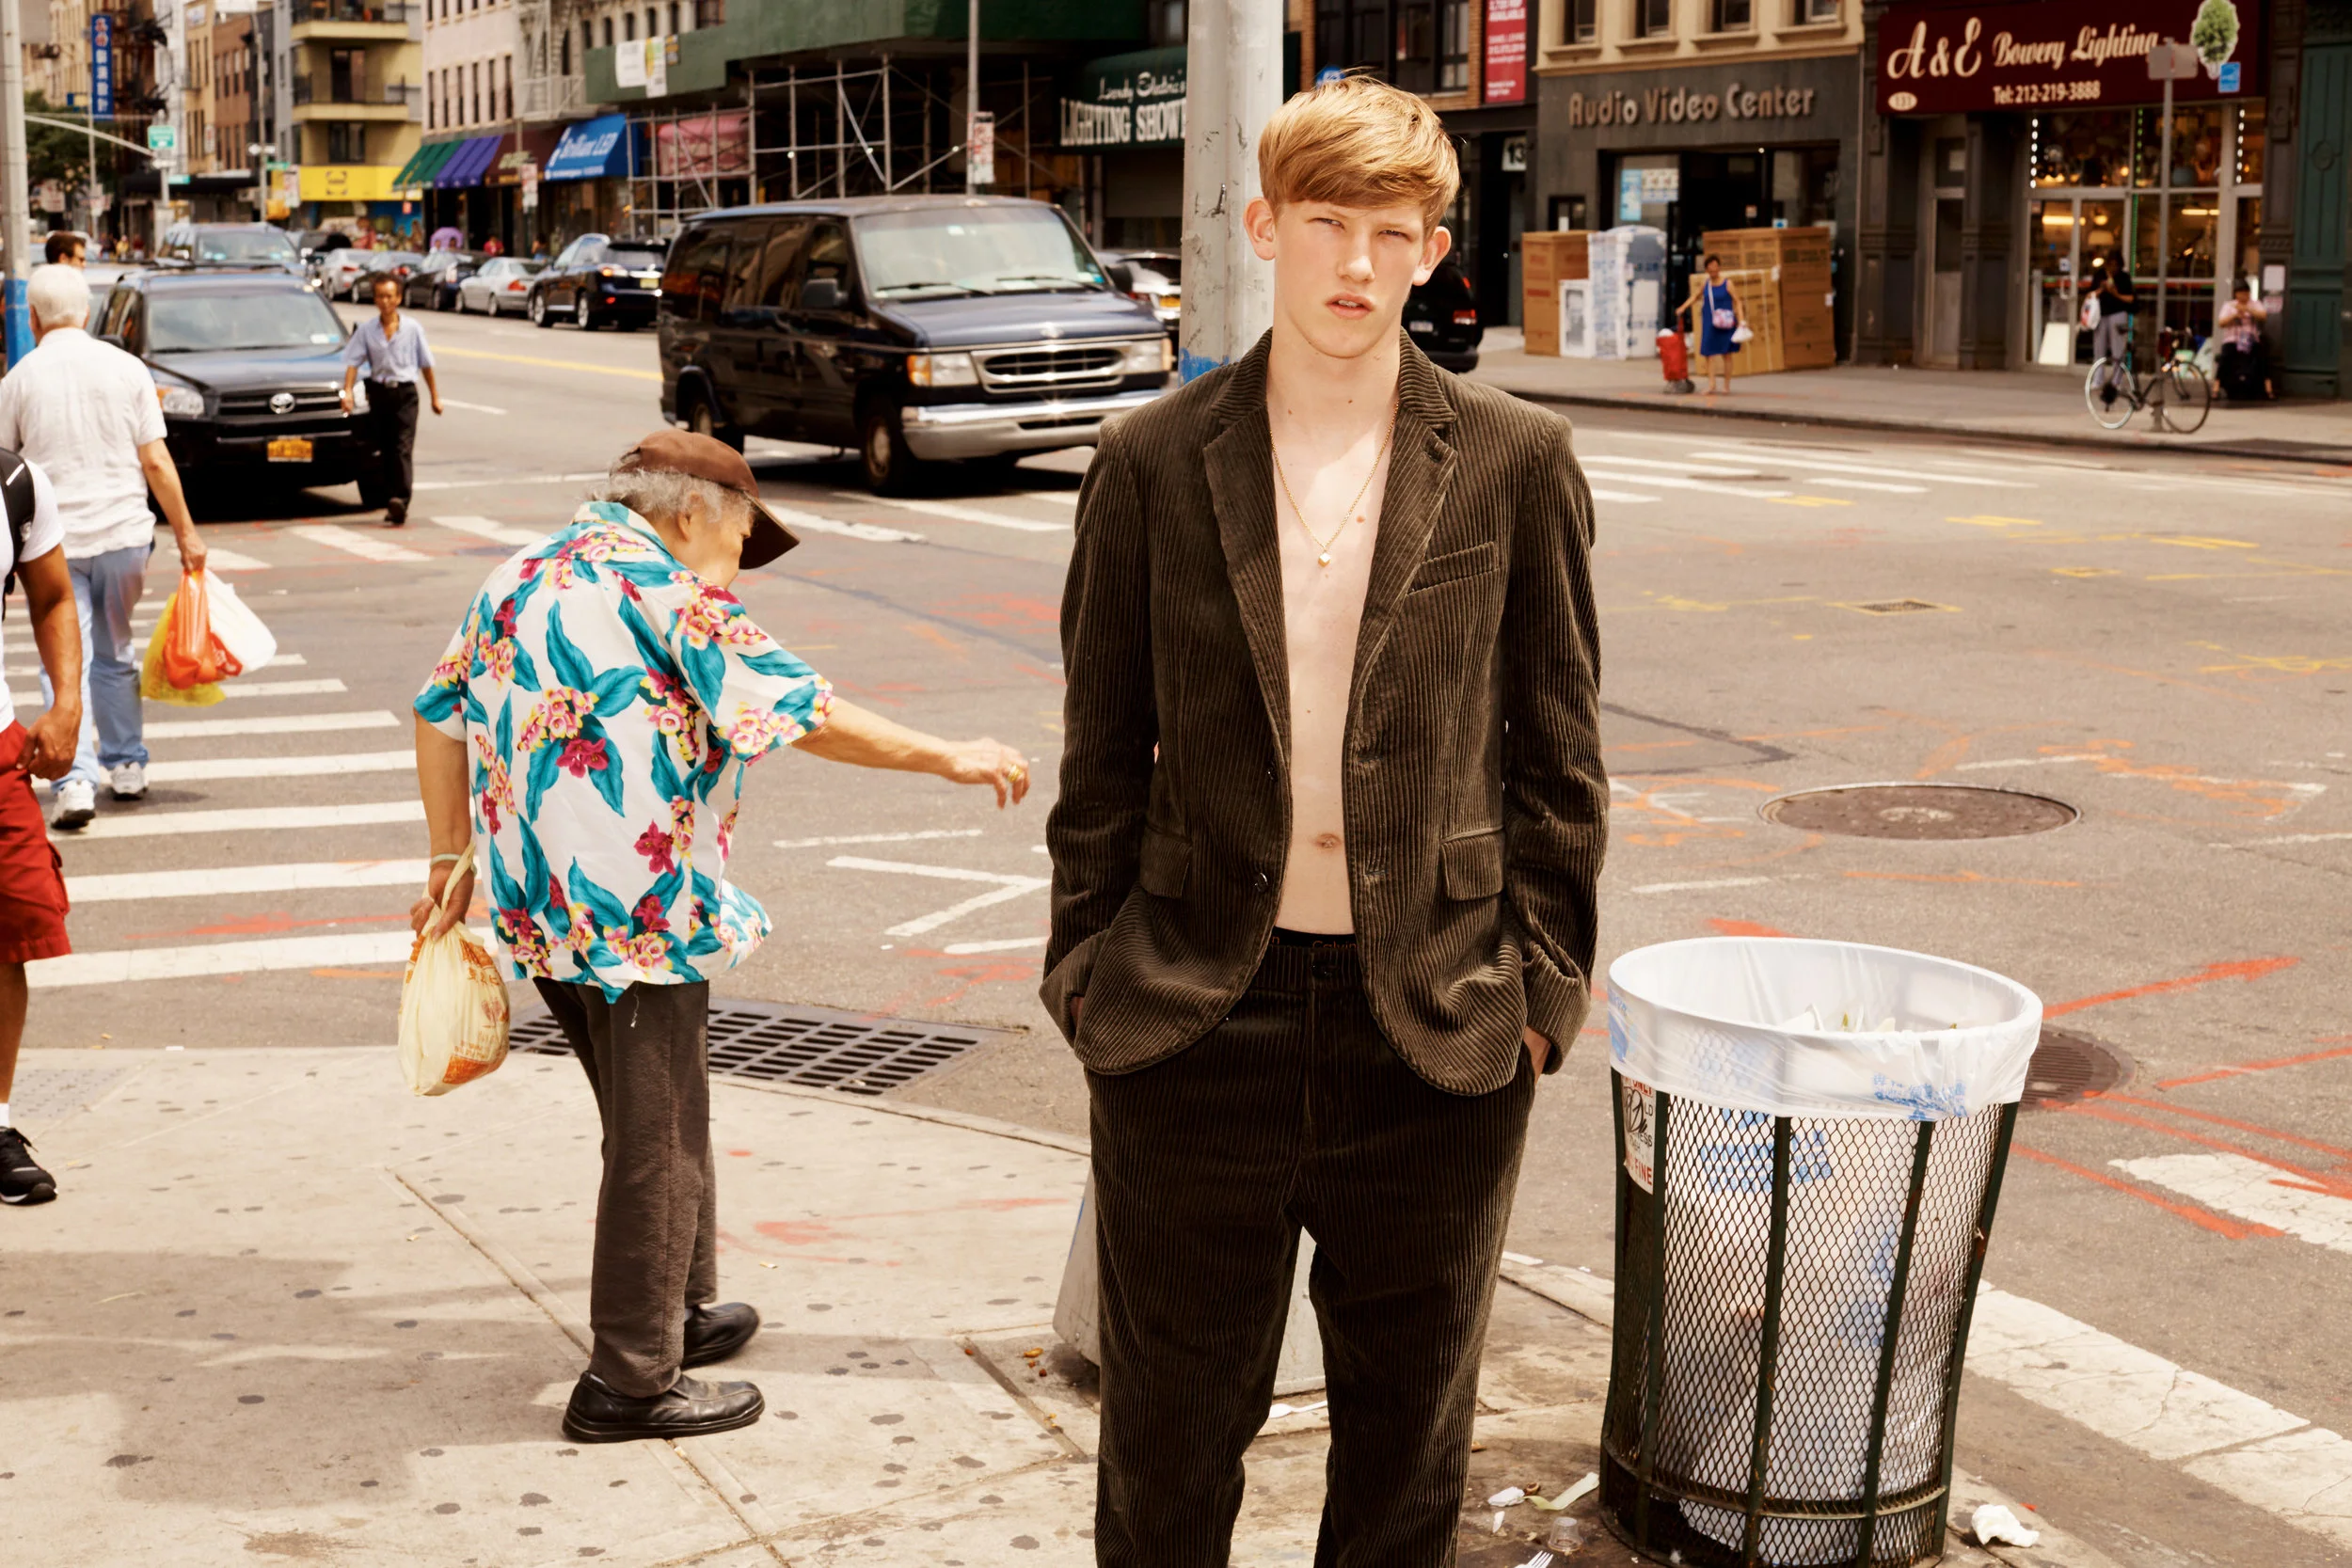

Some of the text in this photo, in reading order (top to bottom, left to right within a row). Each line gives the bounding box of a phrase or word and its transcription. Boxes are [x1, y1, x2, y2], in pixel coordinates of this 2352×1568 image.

[1992, 31, 2066, 71] Bowery
[1060, 97, 1132, 147] LIGHTING
[1569, 83, 1814, 126] Audio Video Center
